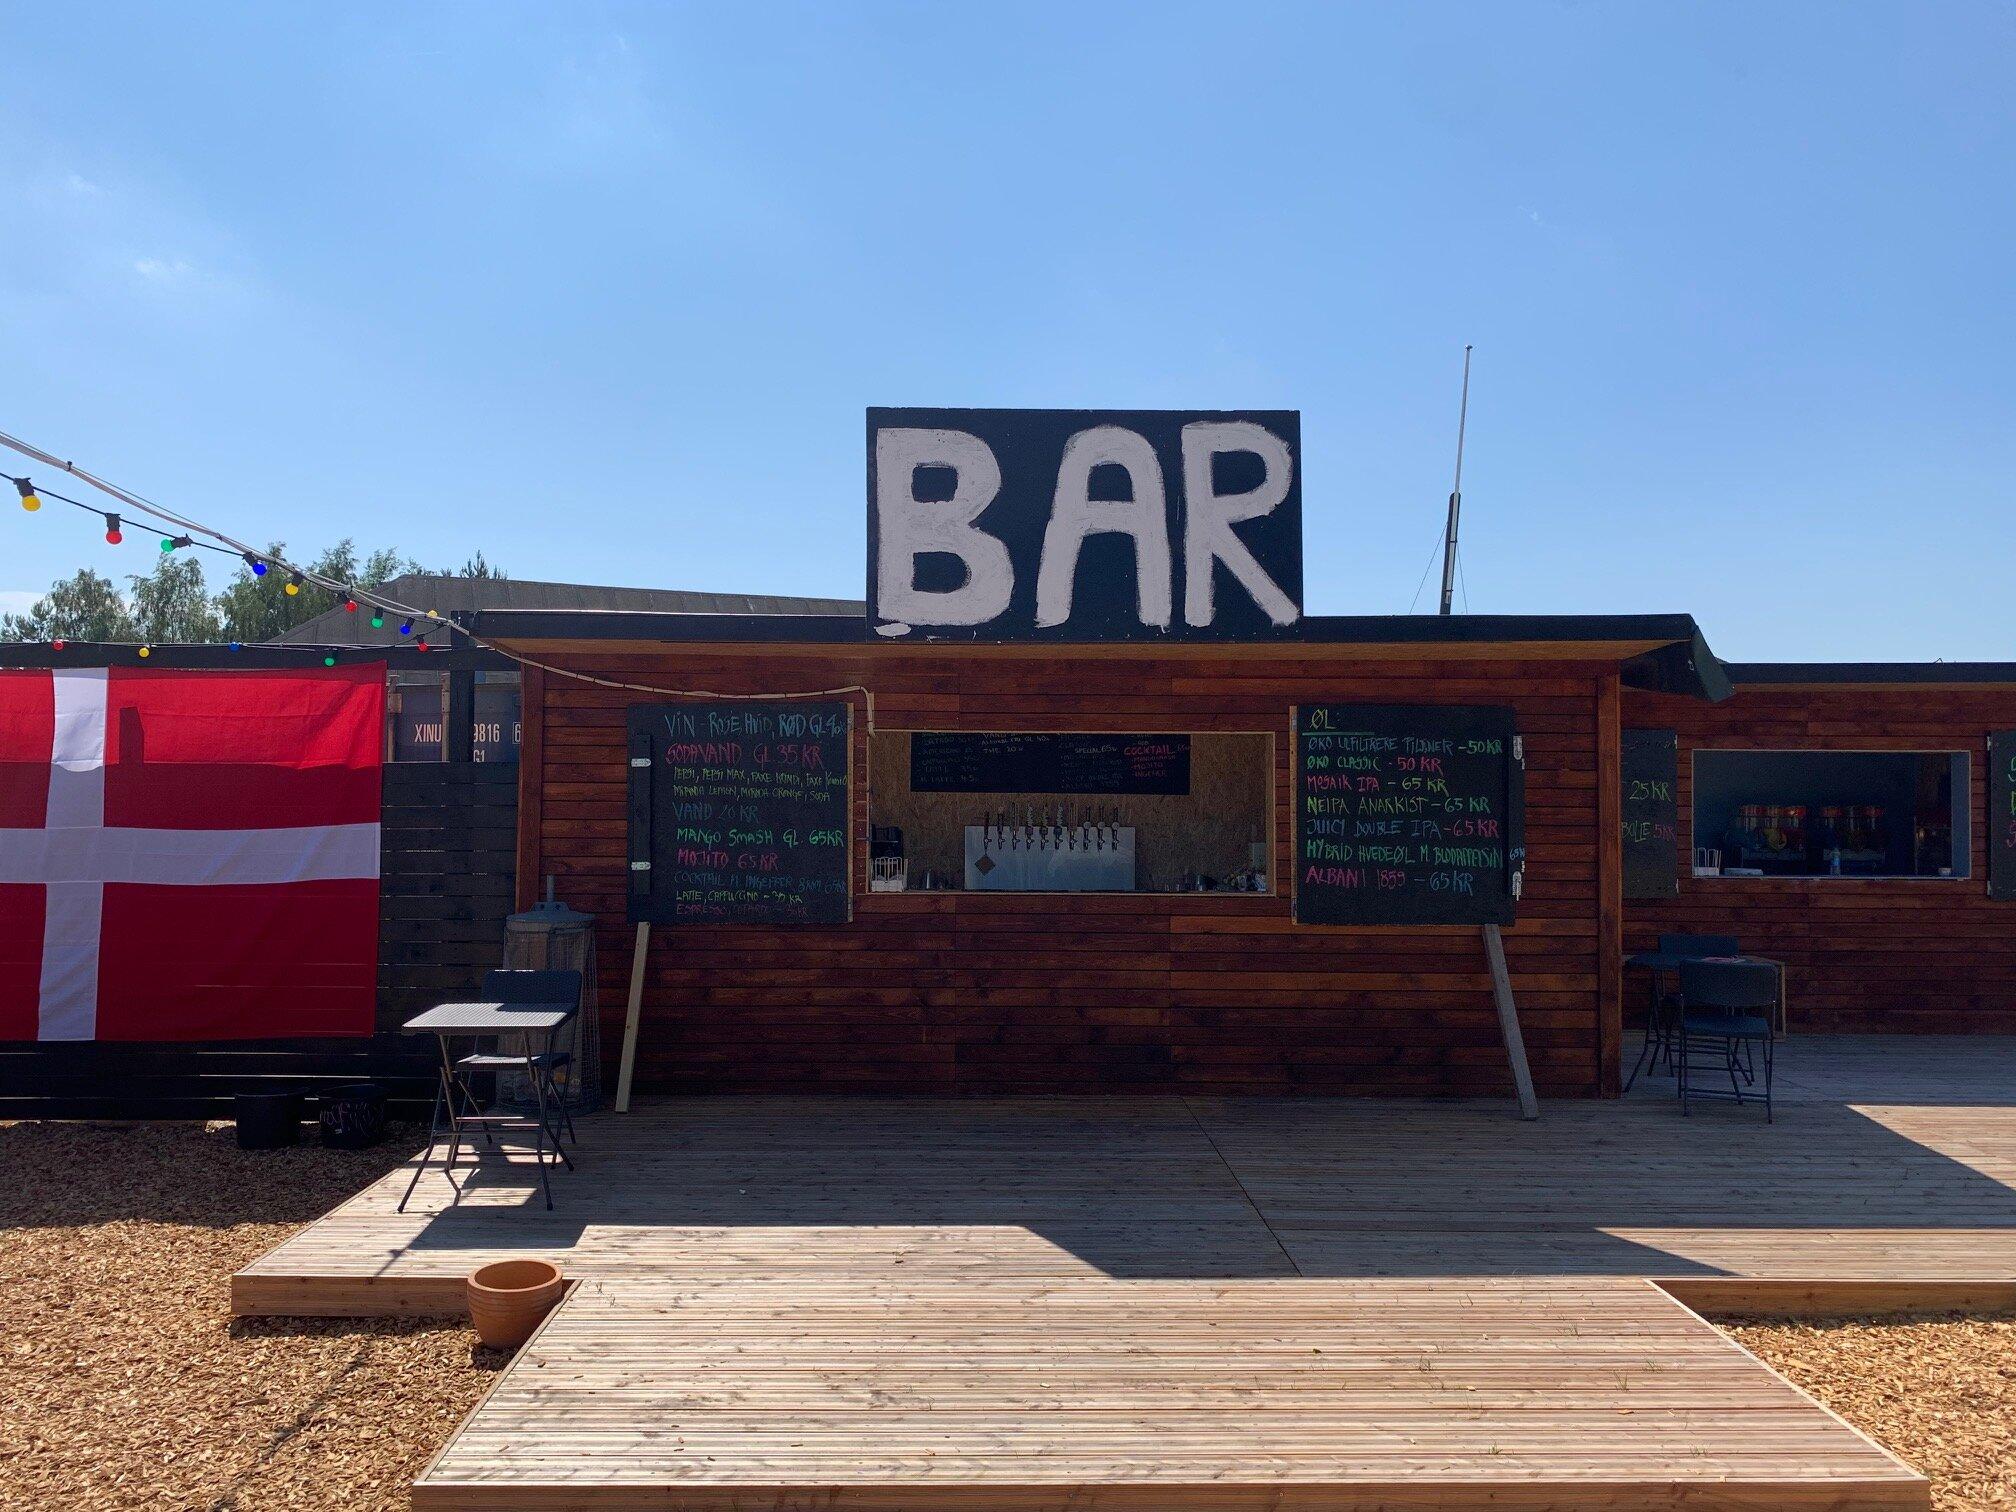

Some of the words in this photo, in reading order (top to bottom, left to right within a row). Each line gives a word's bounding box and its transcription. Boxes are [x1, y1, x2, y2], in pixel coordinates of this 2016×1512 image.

[876, 420, 1301, 633] BAR
[414, 723, 442, 743] XINU
[664, 712, 695, 737] VIN
[1397, 757, 1416, 770] 50
[1420, 756, 1444, 777] KR
[1357, 777, 1380, 792] IPA
[1402, 777, 1422, 790] 65
[1427, 778, 1449, 796] KR
[1358, 796, 1428, 815] ANARKIST
[1444, 798, 1464, 812] 65
[1469, 797, 1491, 814] KR
[1353, 820, 1404, 838] DOUBLE
[676, 828, 722, 851] MANGO
